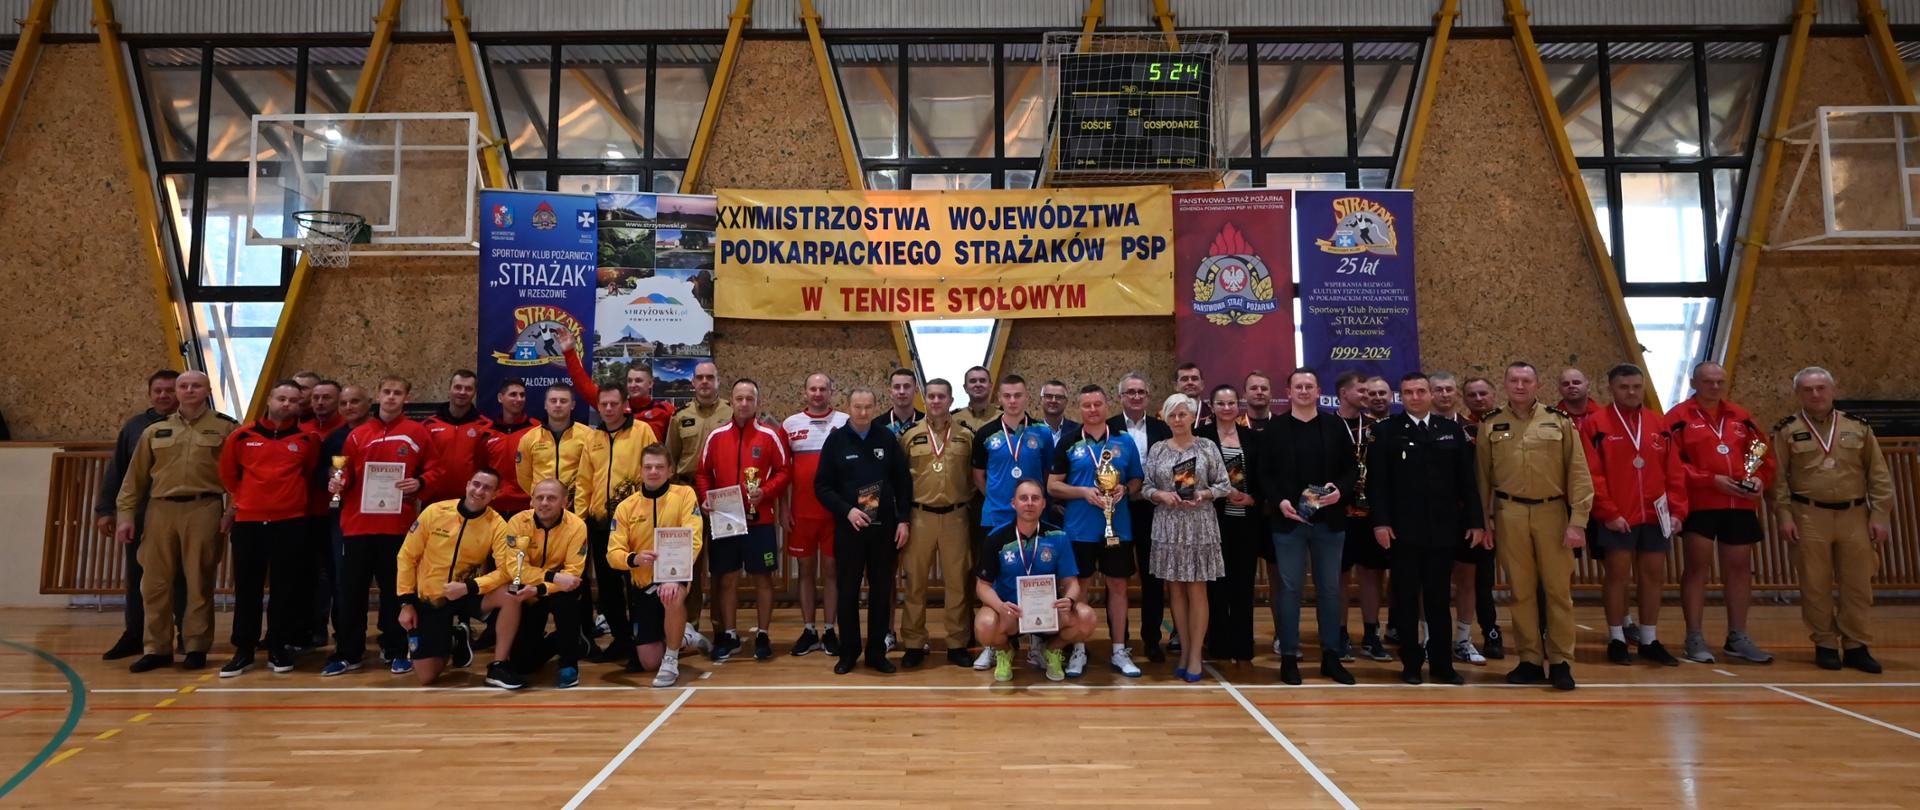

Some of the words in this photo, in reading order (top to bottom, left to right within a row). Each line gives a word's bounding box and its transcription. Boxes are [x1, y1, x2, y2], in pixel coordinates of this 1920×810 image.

[1081, 119, 1112, 130] GOŚCIE
[1143, 121, 1200, 129] GOSPODARZE
[1227, 195, 1249, 203] STRAŻ
[1250, 194, 1284, 202] POŻARNA
[756, 206, 930, 231] MISTRZOSTWA
[948, 198, 1140, 230] WOJEWÓDZTWA
[1333, 197, 1395, 229] STRAŻAK
[492, 248, 530, 258] SPORTOWY
[532, 250, 551, 259] KLUB
[551, 250, 594, 260] POŻARNICZY
[721, 239, 941, 265] PODKARPACKIEGO
[954, 232, 1105, 264] STRAŻAKÓW
[1121, 235, 1166, 261] PSP
[1336, 257, 1359, 275] 25
[1360, 257, 1380, 275] lat
[490, 260, 595, 288] „STRAŻAK”
[519, 289, 527, 297] W
[527, 289, 567, 298] RZESZOWIE
[801, 287, 823, 311] W
[840, 288, 935, 312] TENISIE
[948, 284, 1086, 312] STOŁOWYM
[1193, 302, 1226, 312] PAŃSTWOWA
[1227, 298, 1243, 307] STRAŻ
[1246, 302, 1275, 311] POŻARNA
[1309, 306, 1345, 315] Sportowy
[1368, 306, 1409, 315] Pożarniczy
[515, 305, 582, 337] STRAŻAK
[1344, 328, 1385, 336] Rzeszowie
[1331, 346, 1392, 359] 1999-2024
